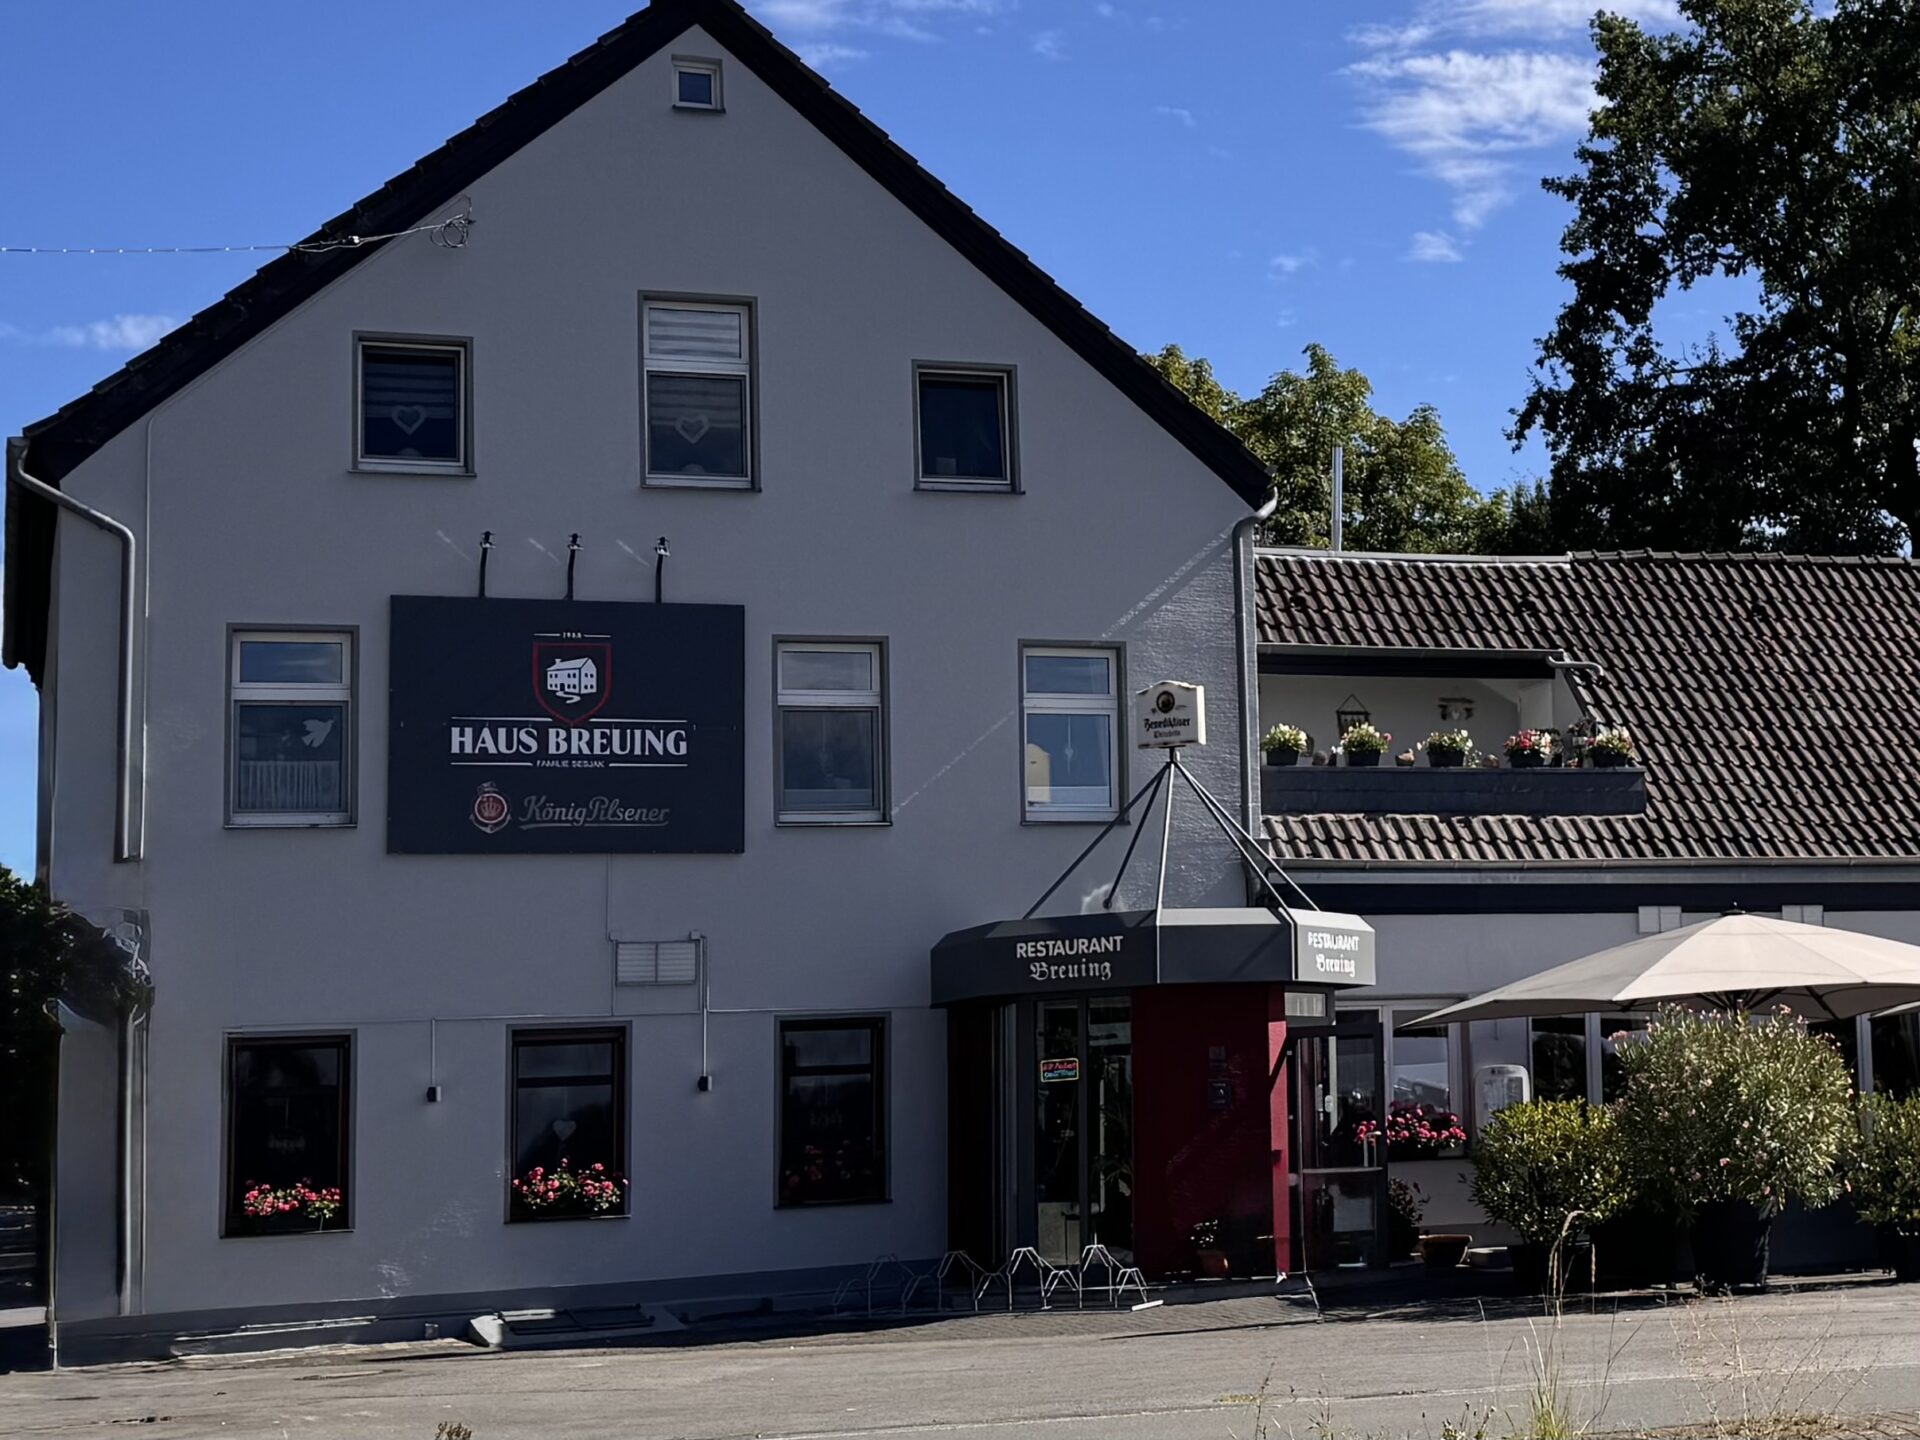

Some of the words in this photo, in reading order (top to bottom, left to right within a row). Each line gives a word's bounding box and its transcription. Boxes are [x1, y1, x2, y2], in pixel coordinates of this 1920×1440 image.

[450, 726, 539, 754] HAUS
[548, 727, 688, 756] BREUING
[537, 759, 570, 768] FAMILIE
[1016, 935, 1124, 959] RESTAURANT
[1308, 931, 1360, 951] RESTAURANT
[1029, 957, 1112, 981] Breuing
[1316, 953, 1356, 978] Breuing
